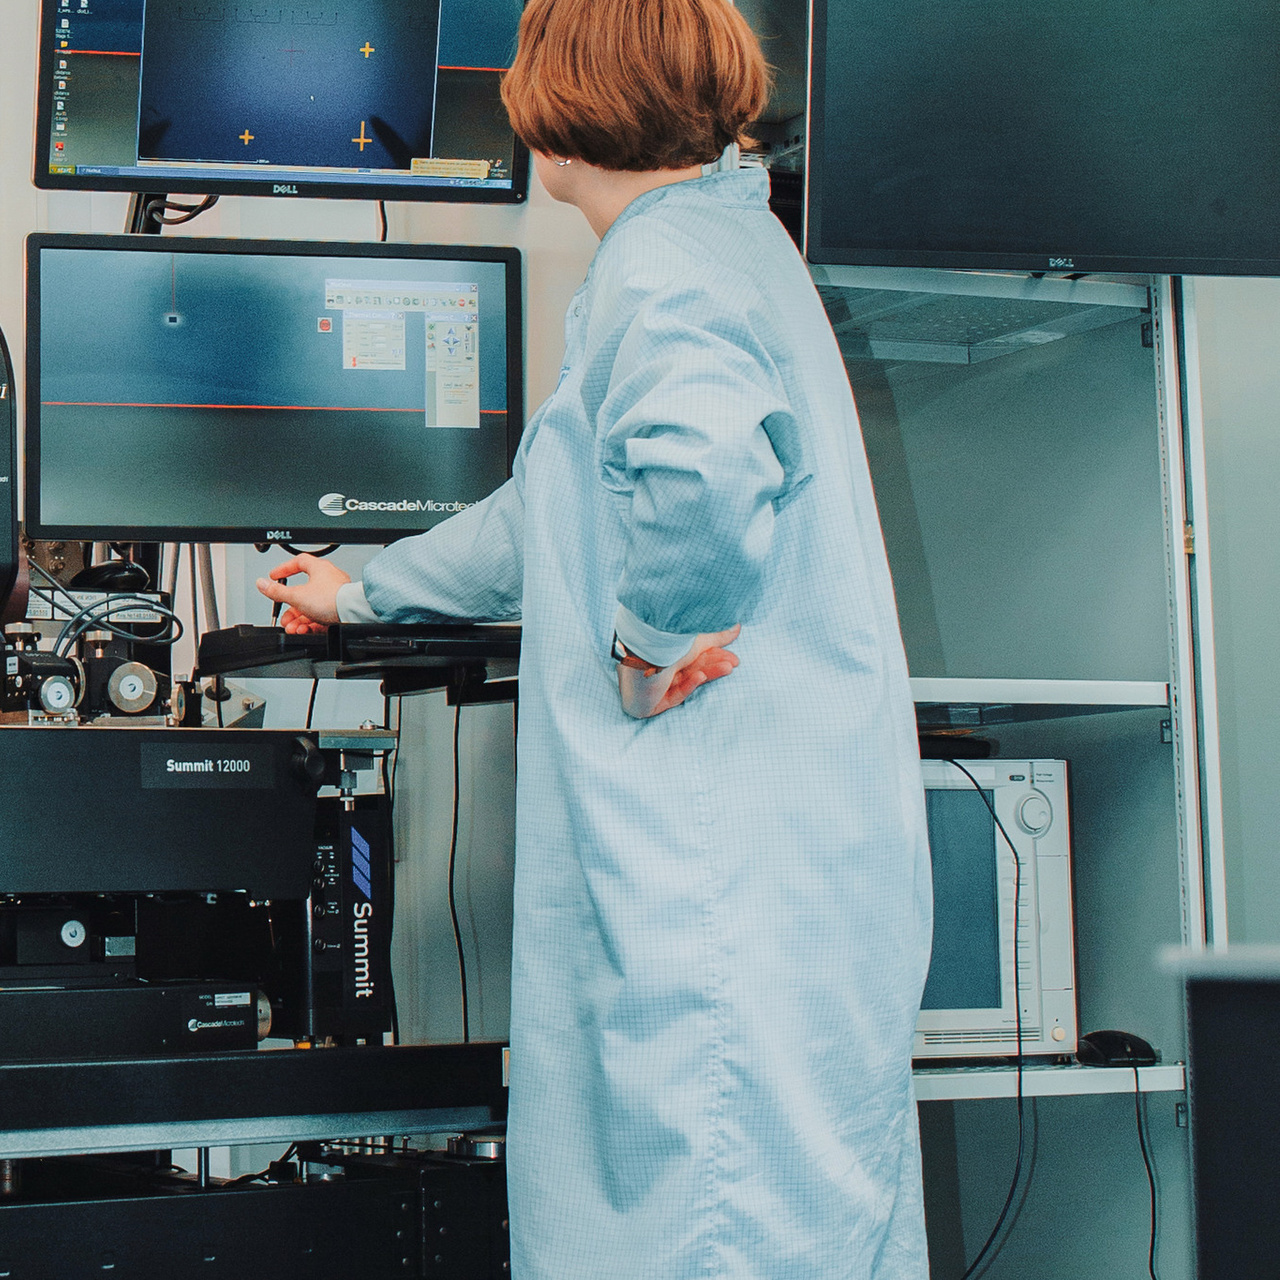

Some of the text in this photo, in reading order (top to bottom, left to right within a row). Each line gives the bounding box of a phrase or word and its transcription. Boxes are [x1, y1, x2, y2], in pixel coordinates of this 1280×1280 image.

[273, 184, 299, 194] DELL
[1049, 257, 1075, 268] DELL
[344, 498, 480, 512] CascadeMicrotec
[266, 530, 293, 540] DELL
[166, 759, 250, 772] Summit 12000
[353, 902, 375, 998] Summit
